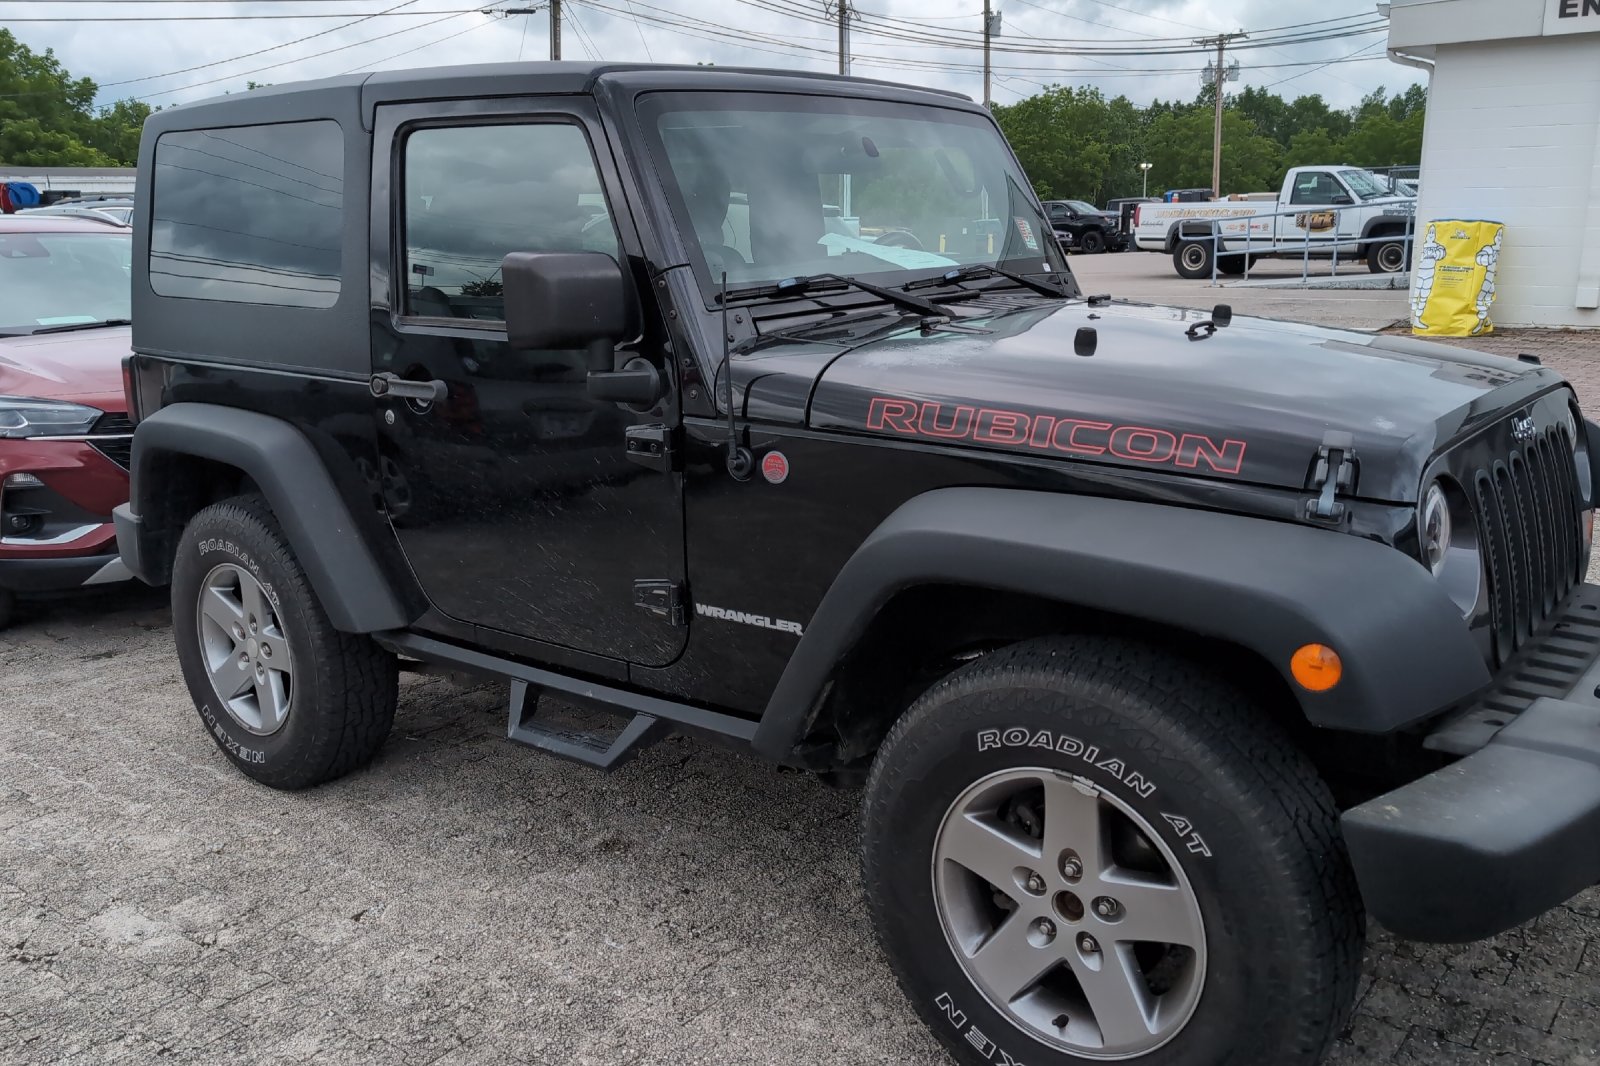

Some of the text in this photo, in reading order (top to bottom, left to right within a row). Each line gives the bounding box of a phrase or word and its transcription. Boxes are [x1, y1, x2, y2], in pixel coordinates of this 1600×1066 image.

[866, 397, 1247, 474] RUBICON
[199, 538, 260, 575] ROADIAN
[696, 603, 804, 636] WRANGLER
[202, 704, 265, 763] NEXEN
[977, 727, 1213, 858] ROADIAN AT
